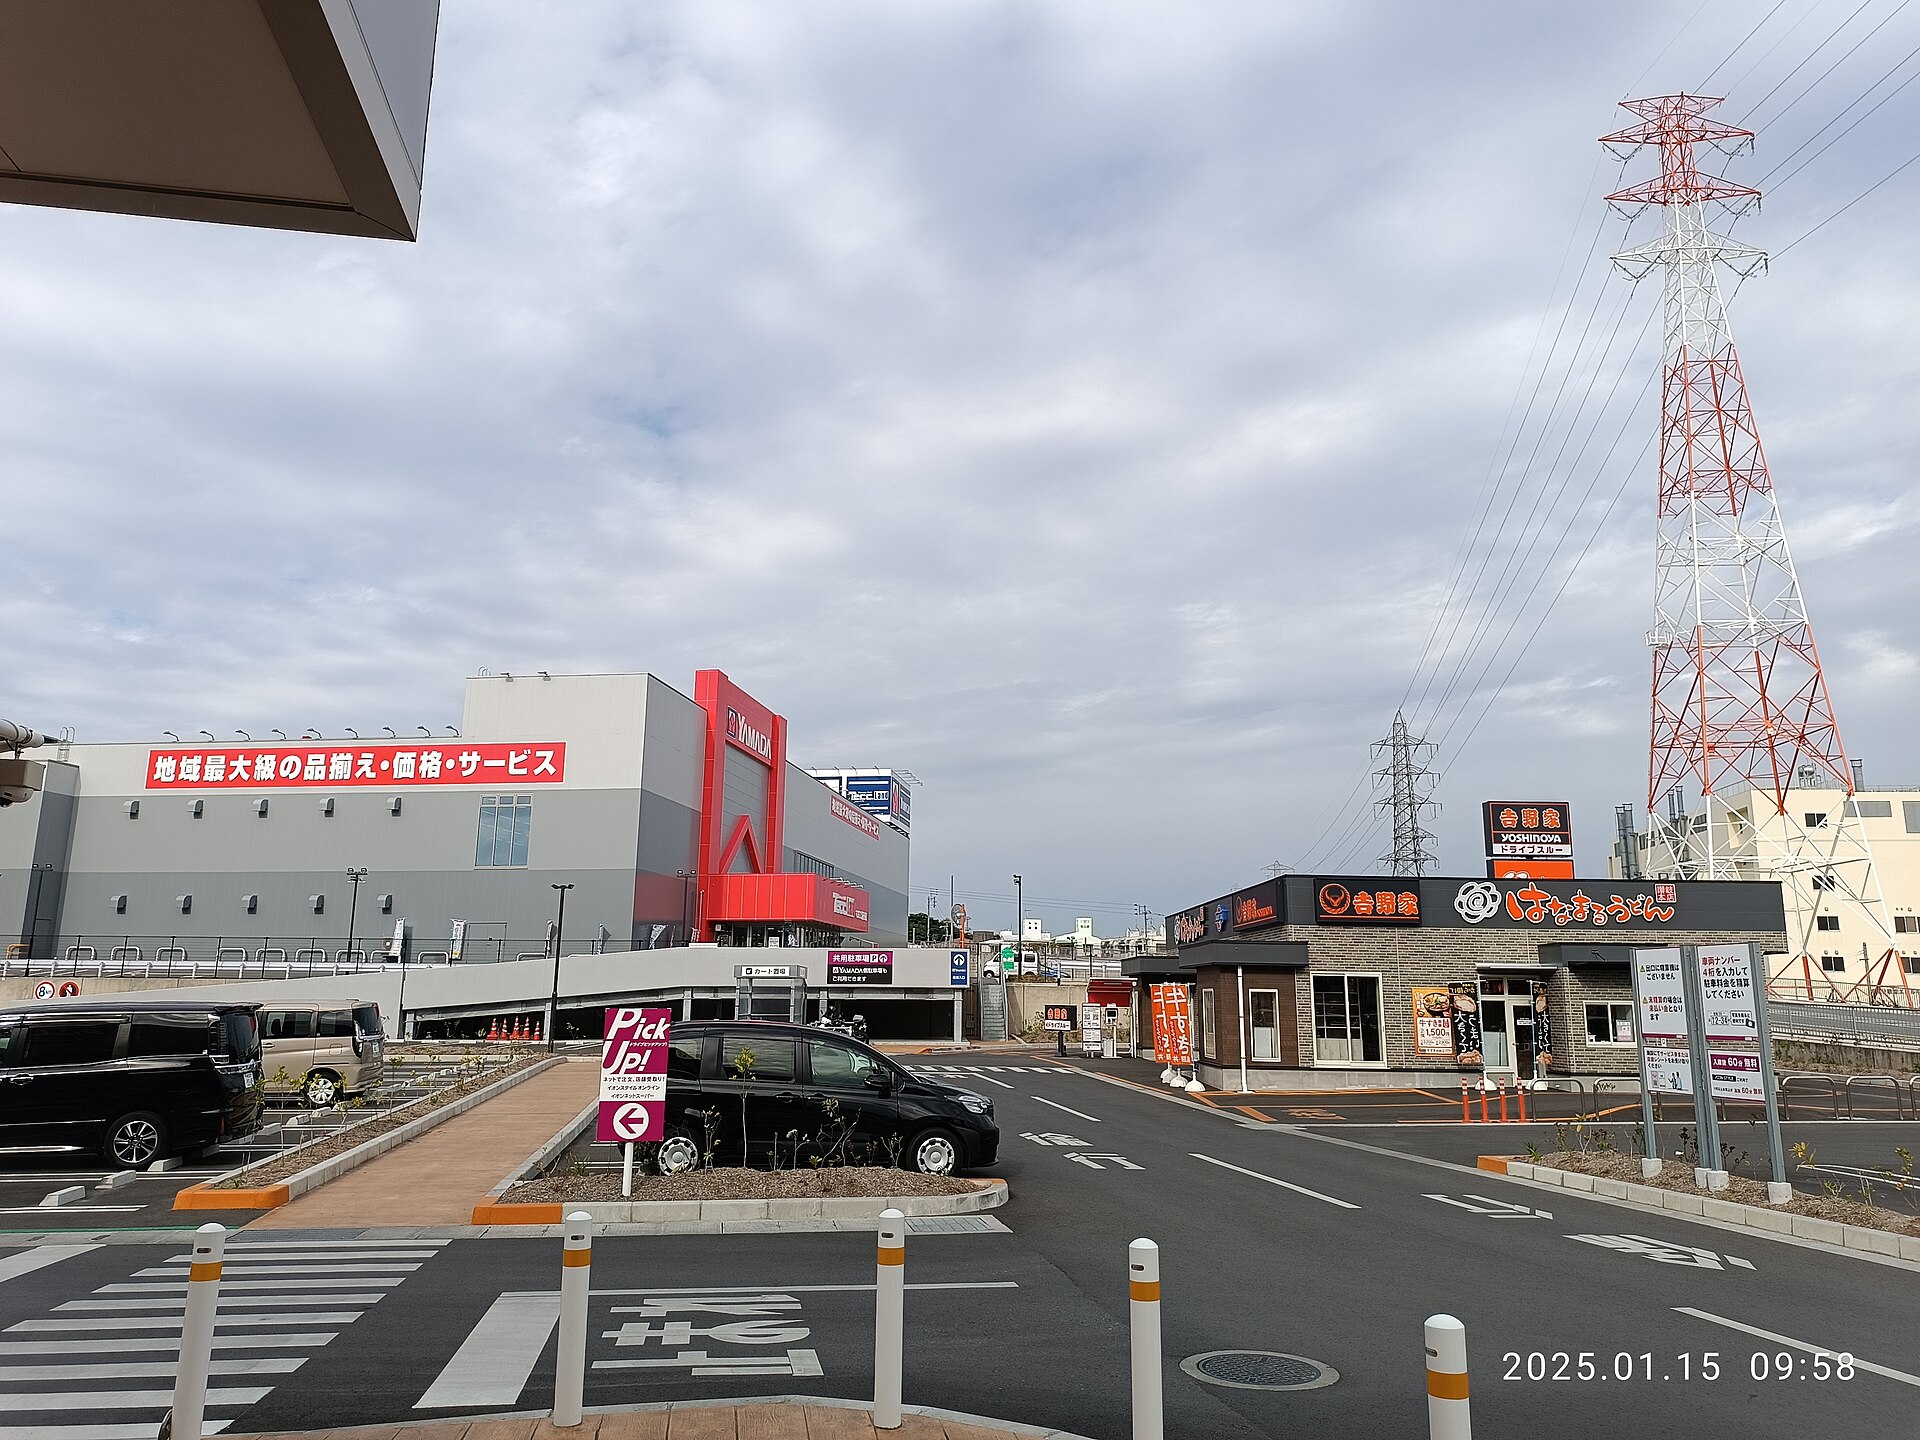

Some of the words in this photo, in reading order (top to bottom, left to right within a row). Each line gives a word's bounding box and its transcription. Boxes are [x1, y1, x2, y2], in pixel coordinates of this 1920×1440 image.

[737, 713, 772, 760] YAMADA
[153, 750, 557, 783] 地域最大級の品揃え・価格・サービス
[1500, 807, 1561, 828] 吉野家
[1501, 834, 1562, 843] YOSHINOYA
[1501, 845, 1563, 853] ドライブスルー
[1352, 891, 1419, 915] 吉野家
[1506, 882, 1676, 926] はなまるうどん
[1701, 956, 1741, 966] 車両ナンバー
[1702, 966, 1748, 977] 4桁を入力して
[1703, 978, 1750, 988] 駐車料金を精算
[38, 986, 45, 997] 8
[1705, 989, 1745, 999] してください
[591, 1293, 825, 1377] 止まれ
